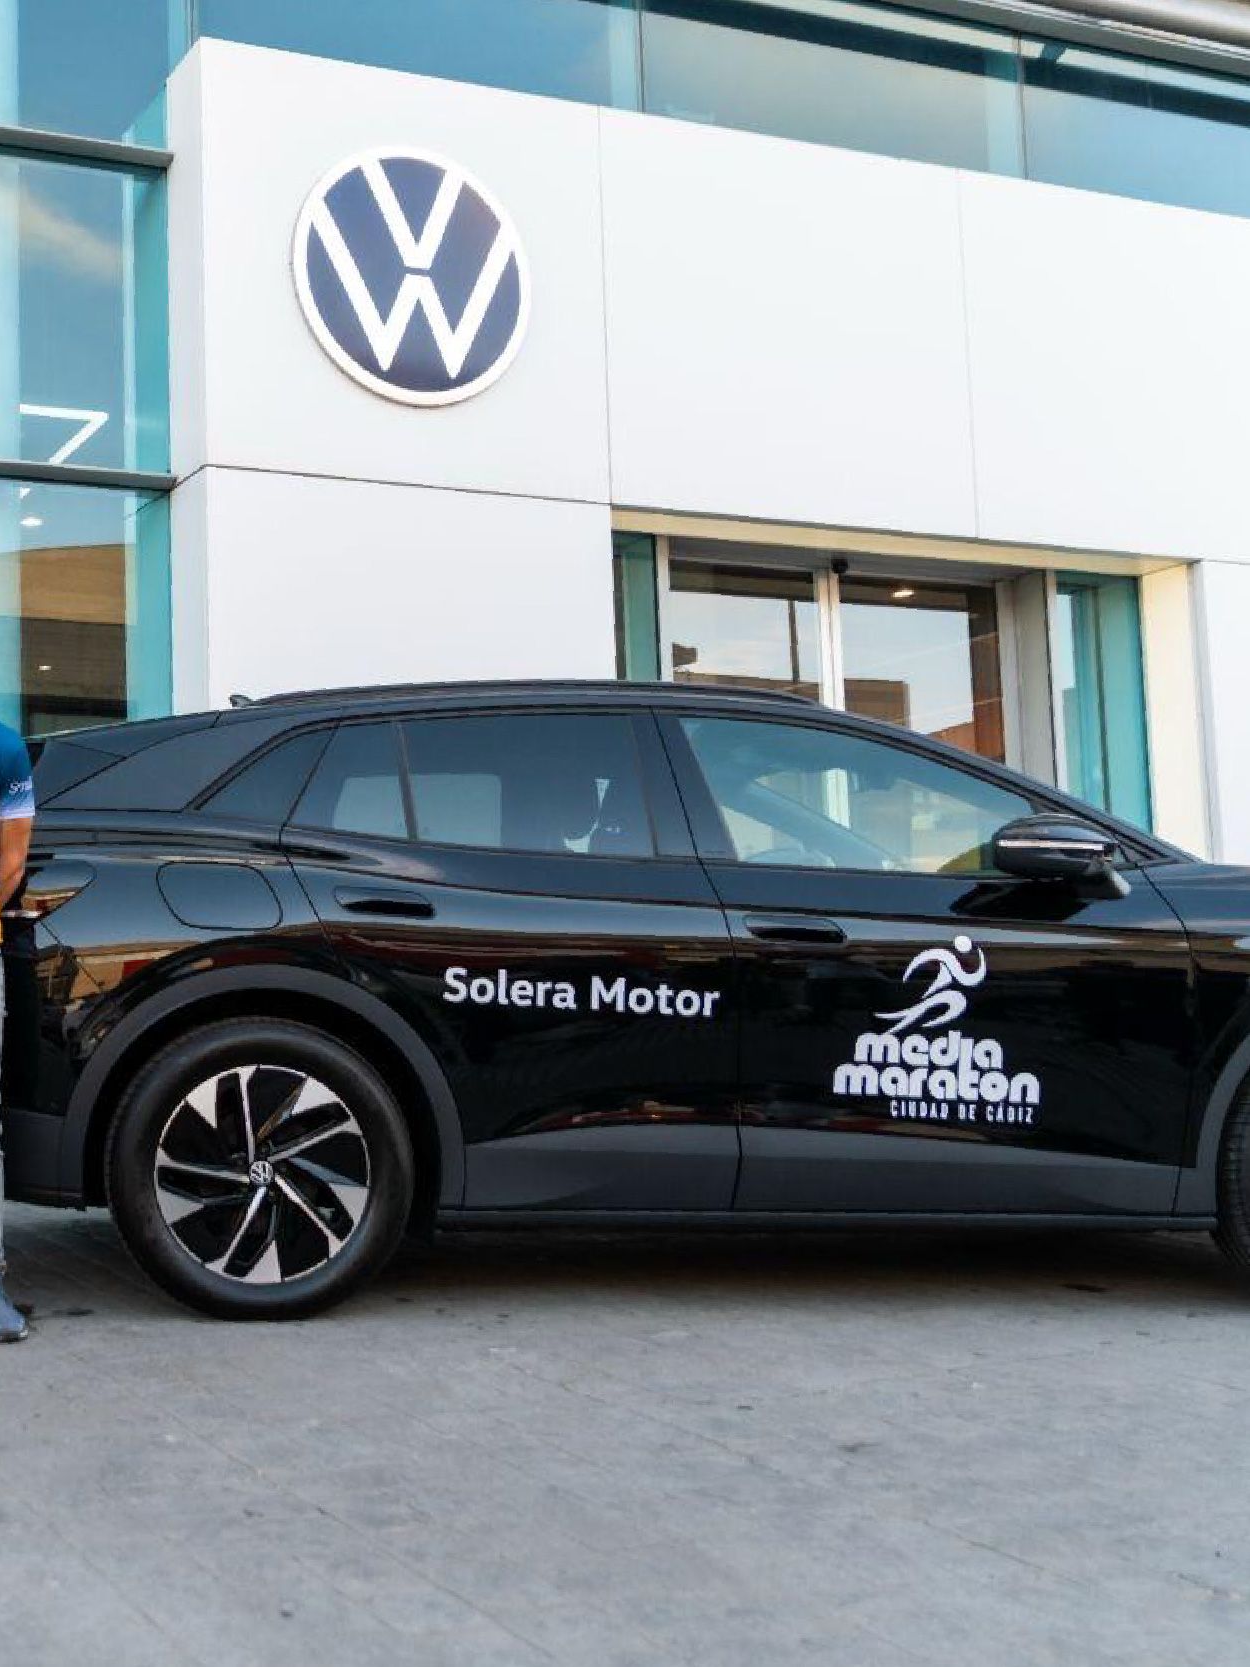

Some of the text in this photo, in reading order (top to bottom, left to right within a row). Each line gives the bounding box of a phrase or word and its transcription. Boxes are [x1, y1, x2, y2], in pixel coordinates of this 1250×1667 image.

[299, 152, 522, 392] VW
[442, 966, 721, 1017] Solera Motor
[853, 1030, 1003, 1068] media
[833, 1063, 1040, 1104] maraton
[890, 1099, 949, 1120] CIUDAD
[958, 1103, 977, 1121] DE
